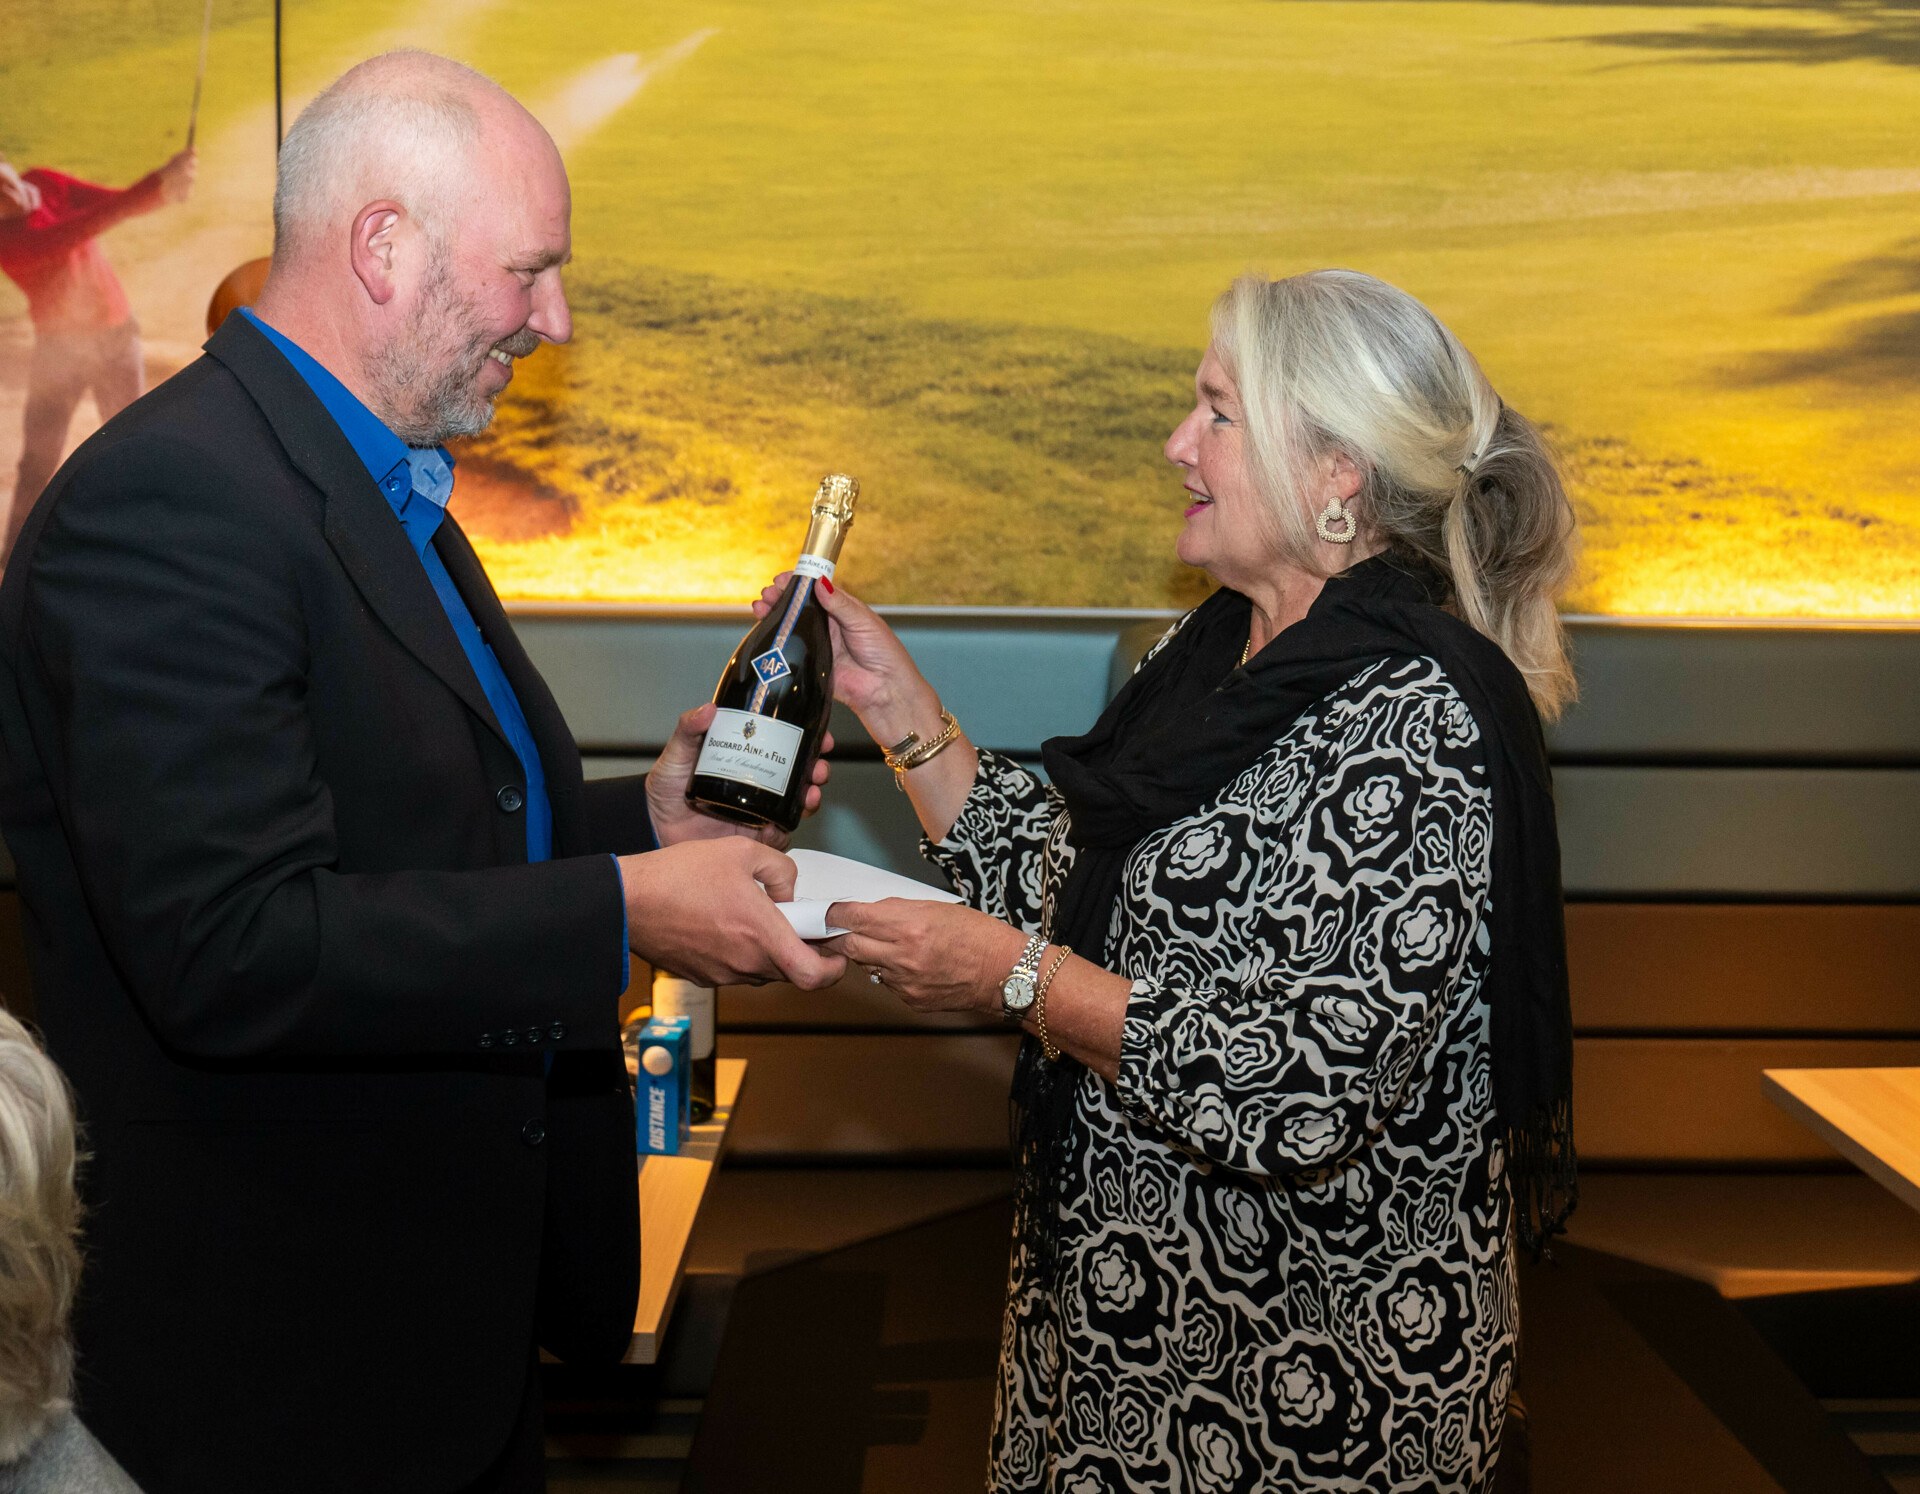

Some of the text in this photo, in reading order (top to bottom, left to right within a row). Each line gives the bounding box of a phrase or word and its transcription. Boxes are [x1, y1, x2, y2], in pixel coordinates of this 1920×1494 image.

[760, 657, 783, 676] BAF
[708, 737, 742, 751] BOUCHARD
[771, 751, 787, 765] FILS
